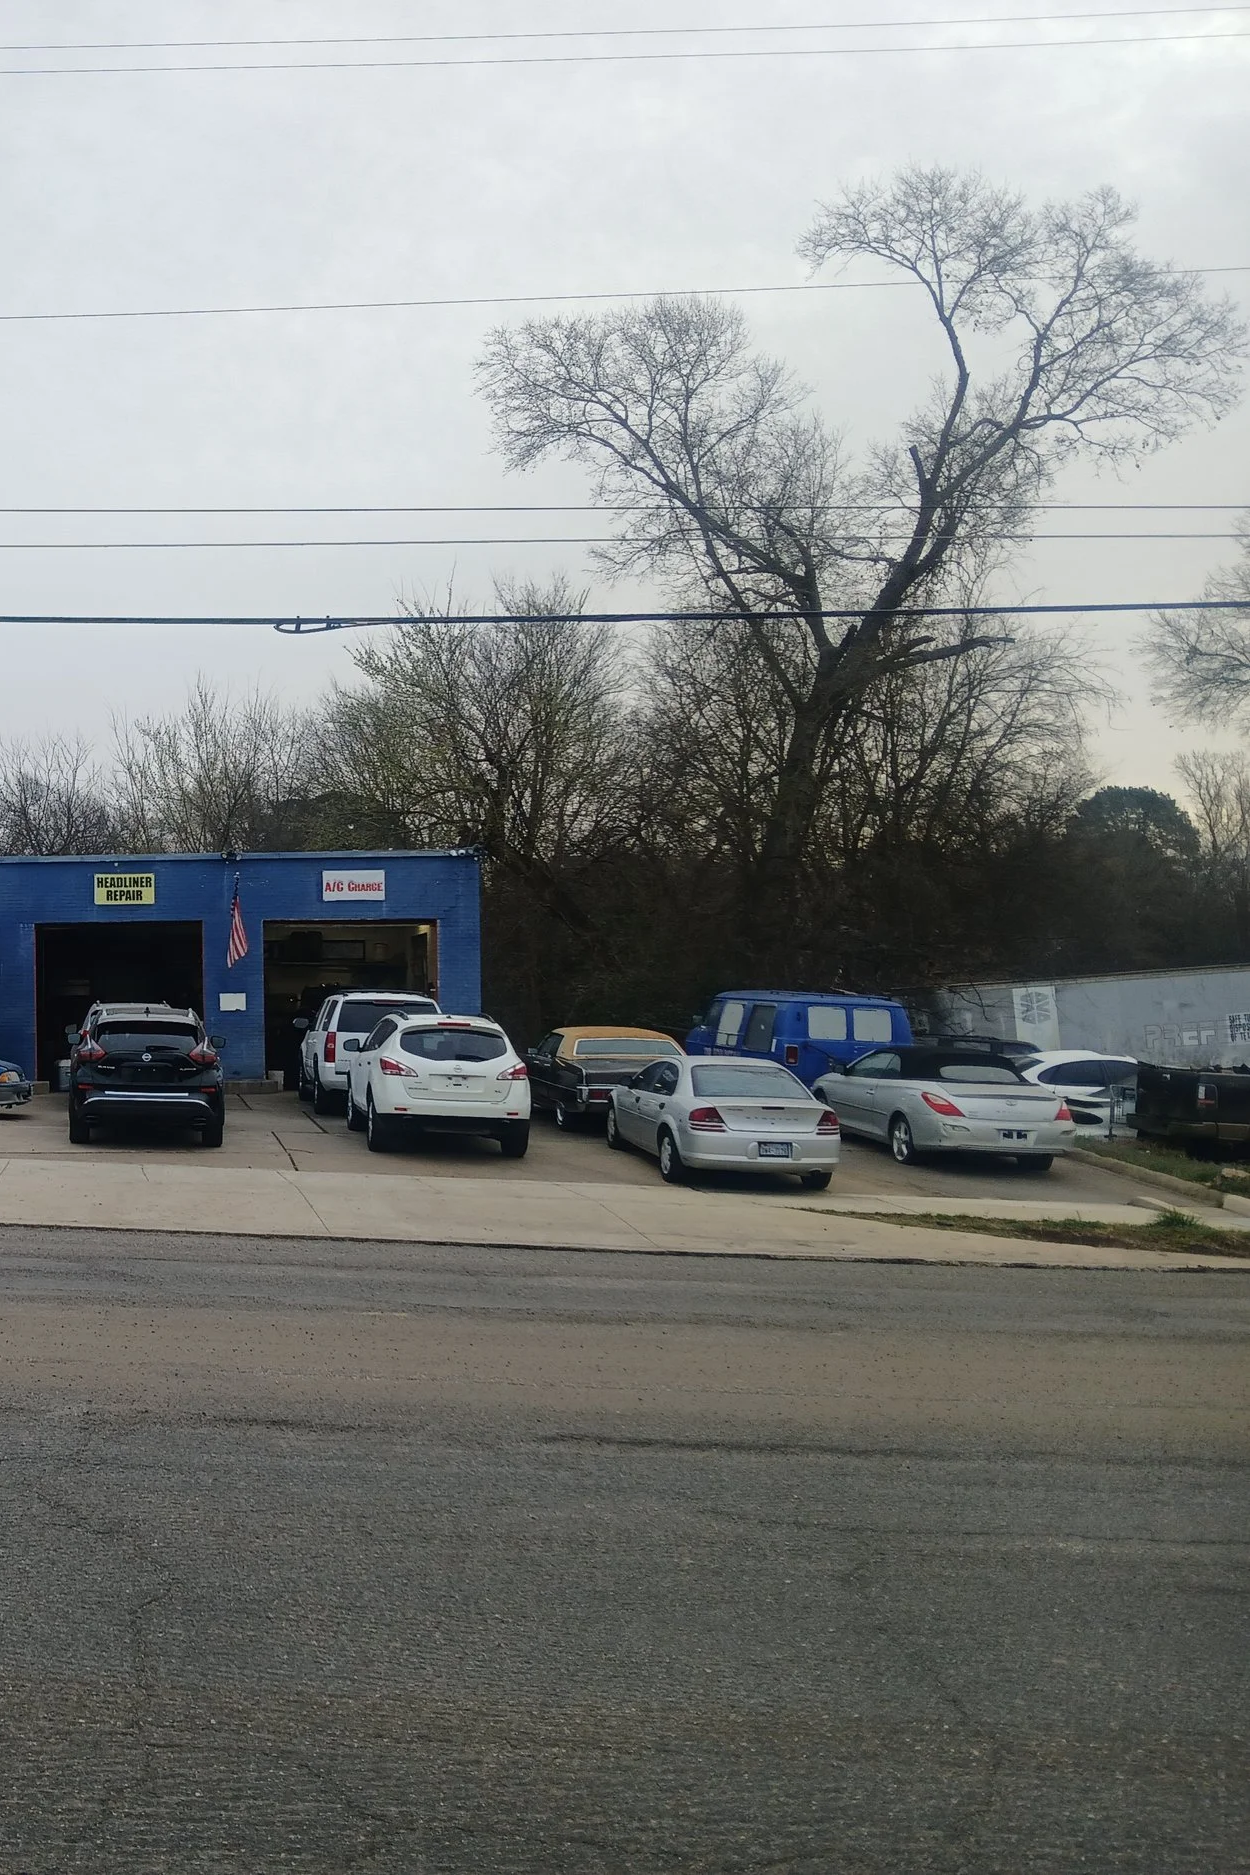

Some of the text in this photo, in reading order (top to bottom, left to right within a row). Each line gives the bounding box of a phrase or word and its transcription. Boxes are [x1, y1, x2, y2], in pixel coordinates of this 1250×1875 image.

[96, 876, 152, 888] HEADLINER
[324, 881, 344, 892] A/C
[106, 890, 143, 901] REPAIR
